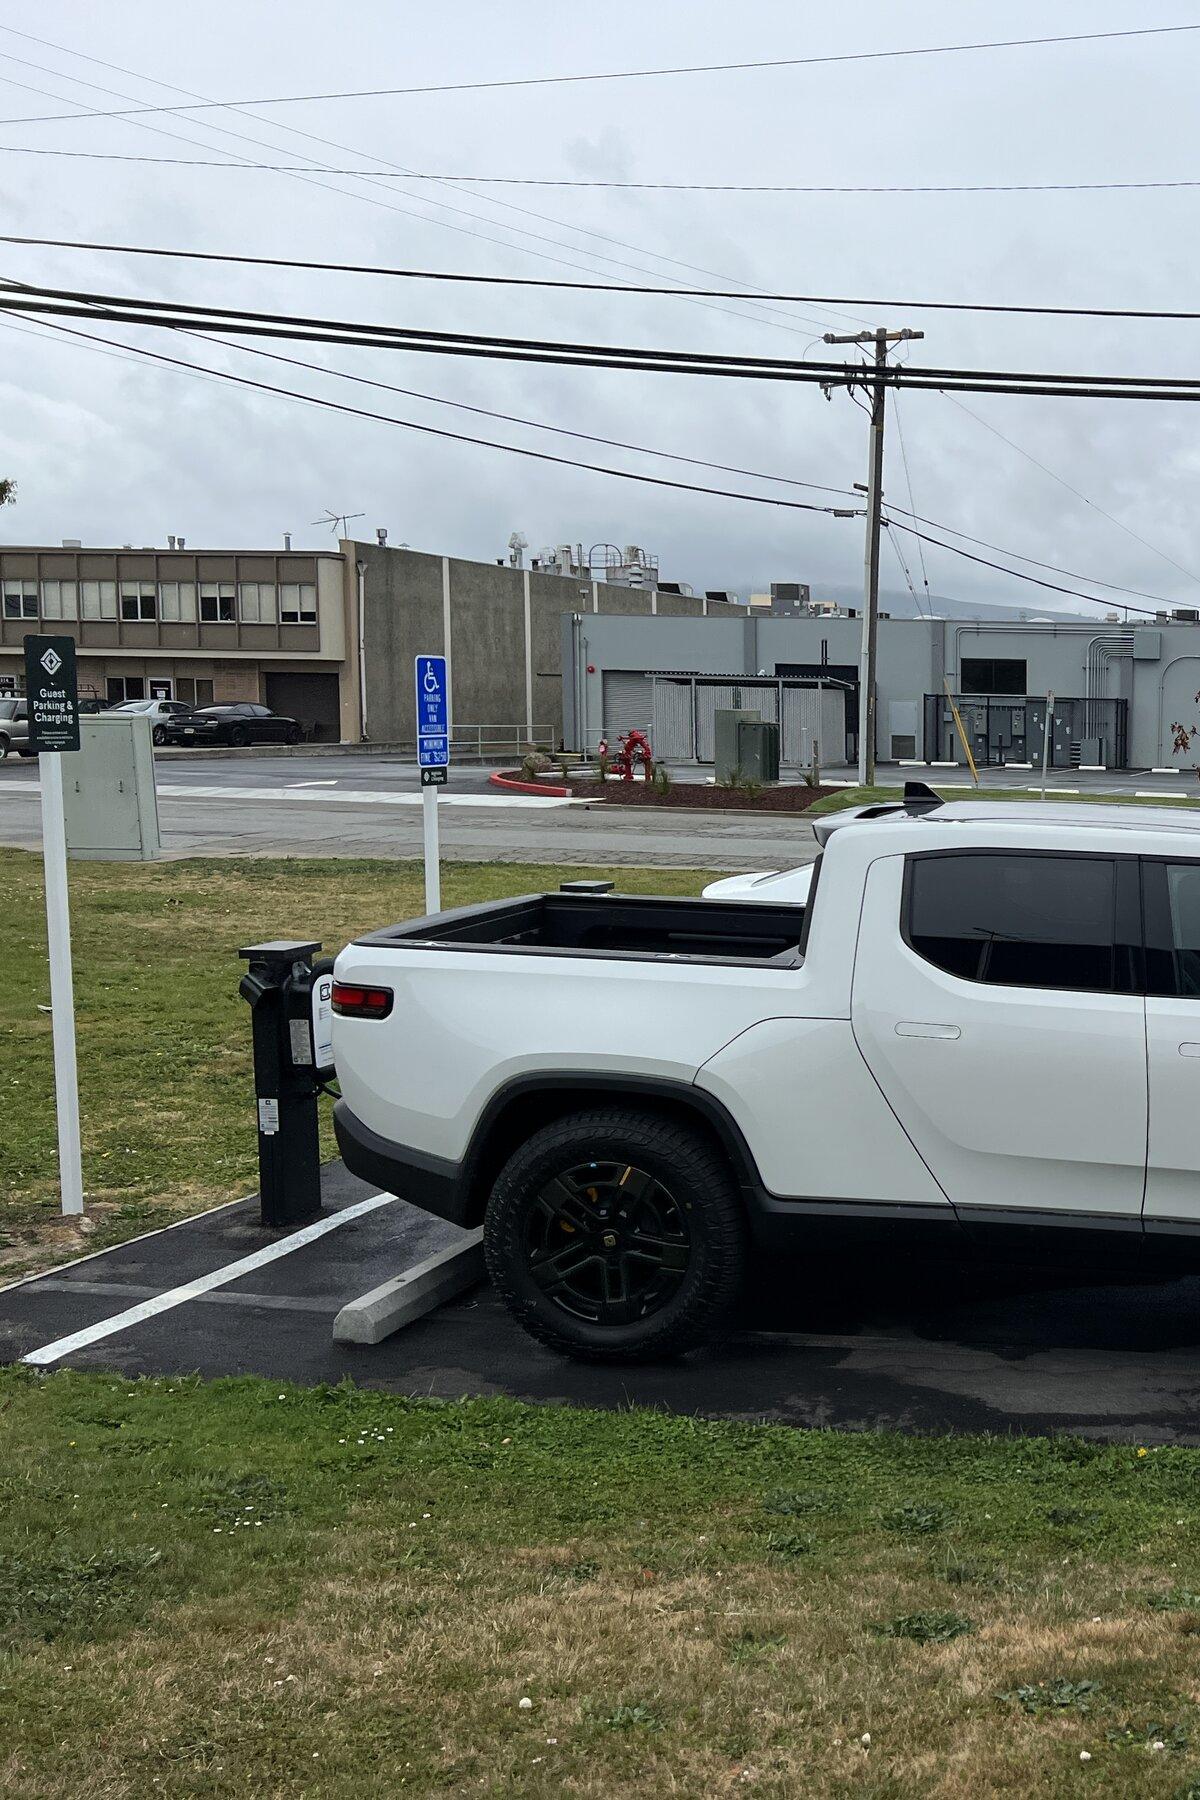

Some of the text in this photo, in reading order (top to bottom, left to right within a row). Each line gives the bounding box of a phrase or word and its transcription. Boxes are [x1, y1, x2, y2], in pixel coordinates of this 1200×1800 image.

[39, 688, 66, 698] Guest
[33, 700, 73, 712] Parking &
[427, 704, 438, 713] ONLY
[34, 712, 74, 725] Charging
